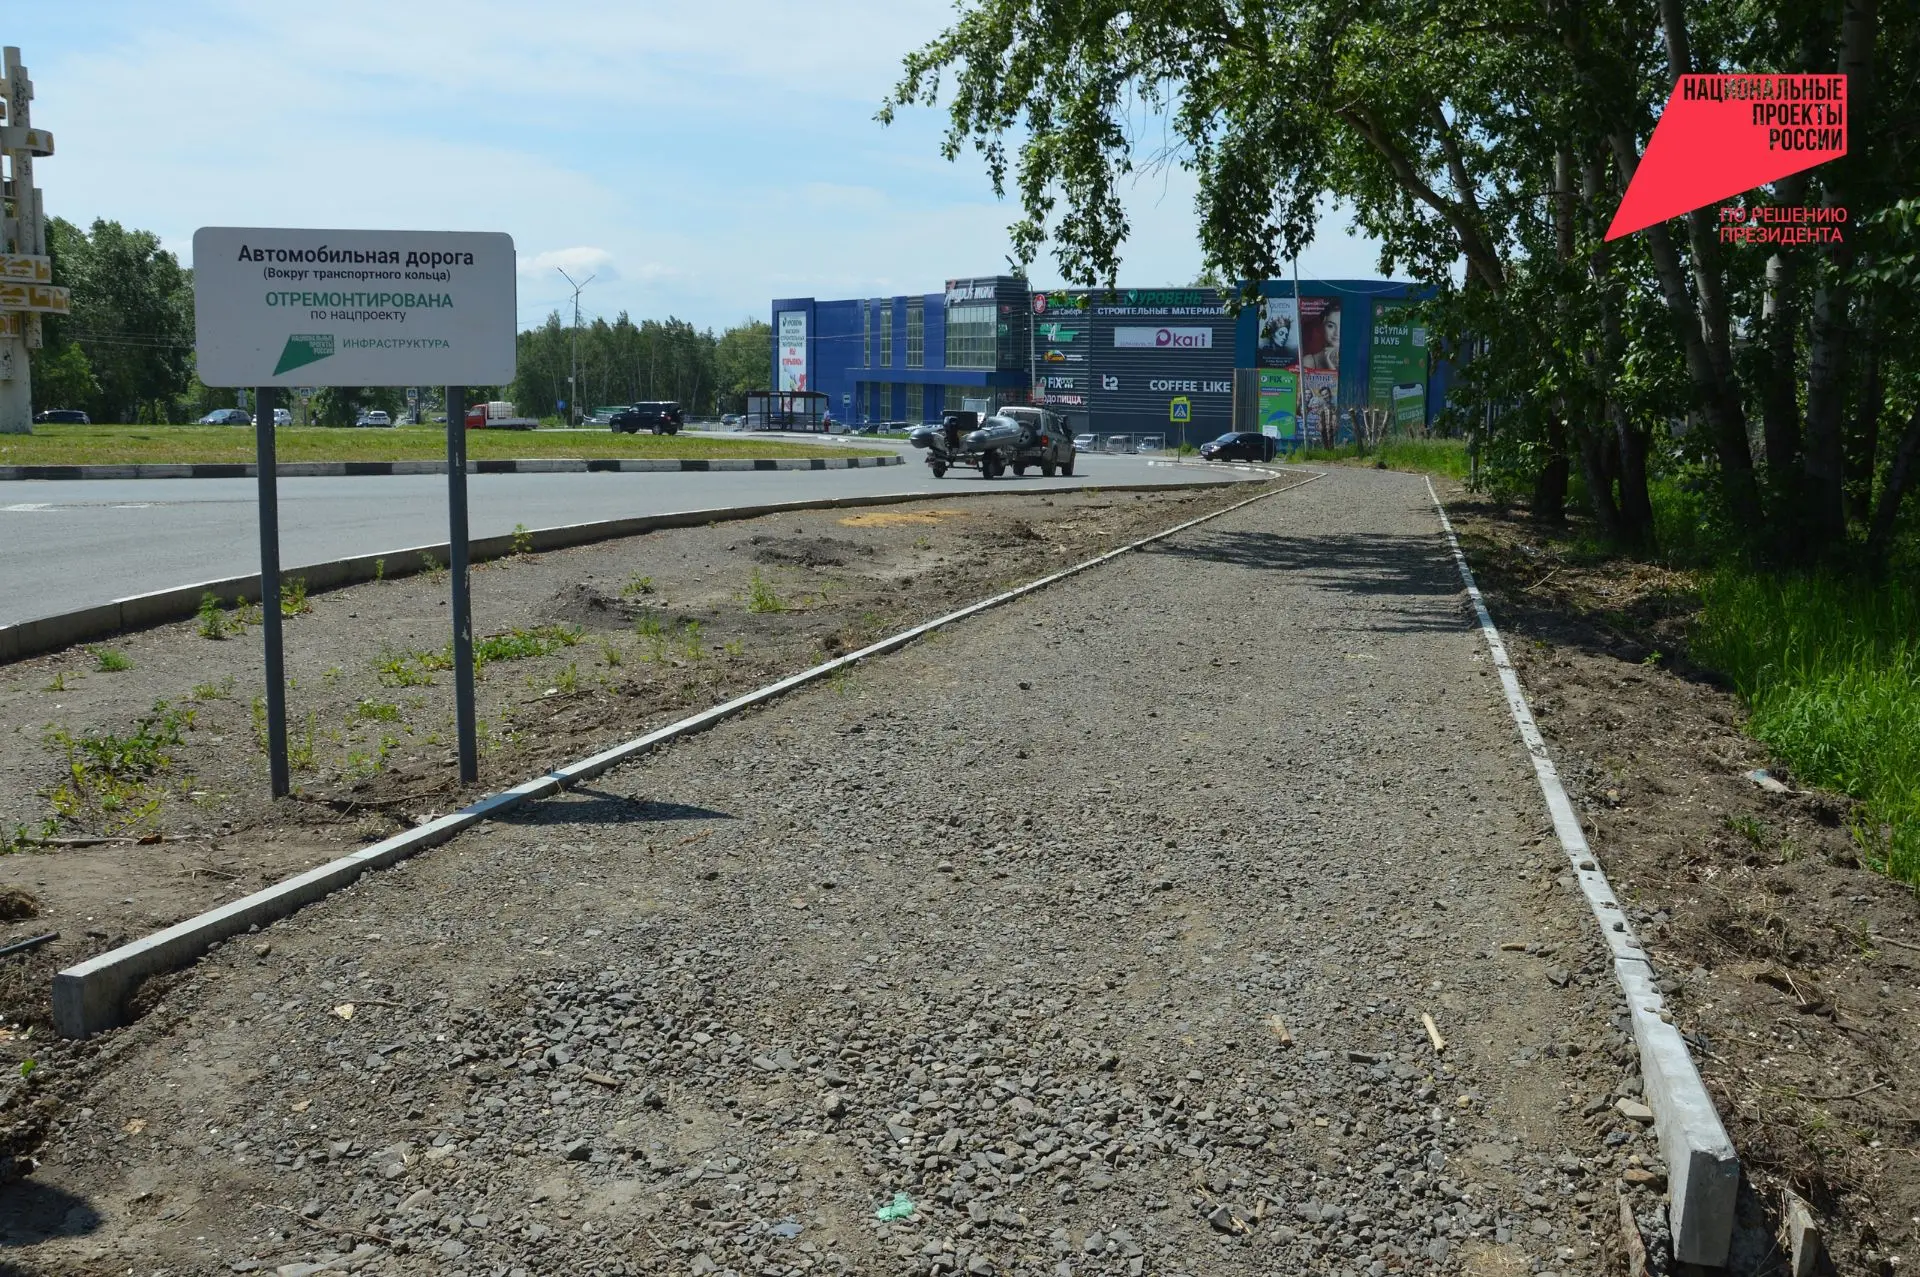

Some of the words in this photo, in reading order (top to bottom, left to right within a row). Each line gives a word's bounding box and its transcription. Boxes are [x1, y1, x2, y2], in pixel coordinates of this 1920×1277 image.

[237, 245, 400, 265] Автомобильная
[405, 250, 474, 268] дорога
[263, 266, 311, 281] (Вокруг
[313, 269, 402, 281] транспортного
[404, 268, 451, 282] кольца)
[265, 291, 454, 309] ОТРЕМОНТИРОВАНА
[1139, 291, 1203, 305] УРОВЕНЬ
[310, 310, 328, 320] по
[330, 310, 407, 322] нацпроекту
[1097, 307, 1169, 315] СТРОИТЕЛЬНЫЕ
[1374, 325, 1409, 336] ВСТУПАЙ
[342, 338, 450, 349] ИНФРАСТРУКТУРА
[1173, 333, 1206, 347] kari
[1374, 336, 1379, 345] В
[1380, 336, 1400, 345] КЛУБ
[1150, 380, 1198, 392] COFFEE
[1203, 381, 1232, 393] LIKE
[1056, 395, 1082, 406] ПИЦЦА
